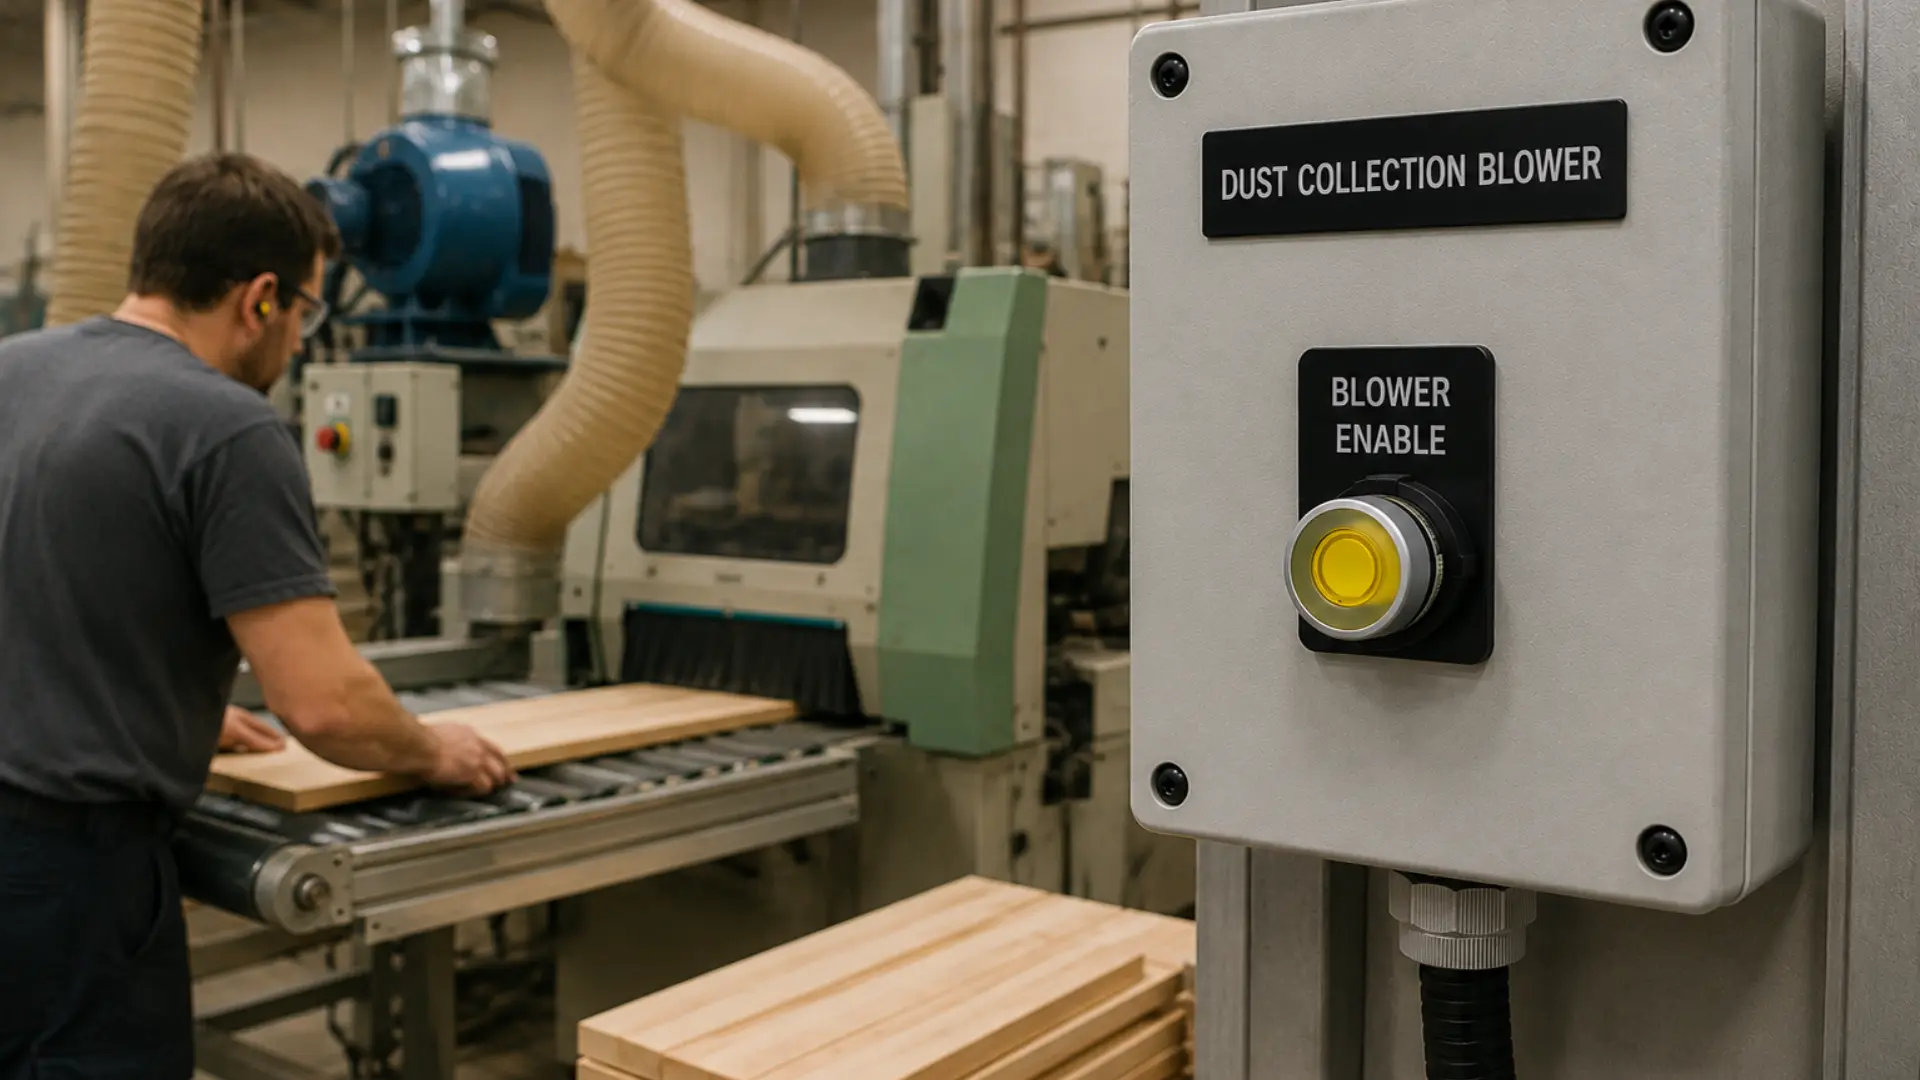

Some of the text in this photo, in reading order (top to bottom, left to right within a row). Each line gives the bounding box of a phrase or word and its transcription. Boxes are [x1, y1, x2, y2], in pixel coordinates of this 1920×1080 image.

[1221, 145, 1602, 201] DUST COLLECTION BLOWER
[1332, 376, 1451, 407] BLOWER
[1336, 423, 1446, 455] ENABLE
